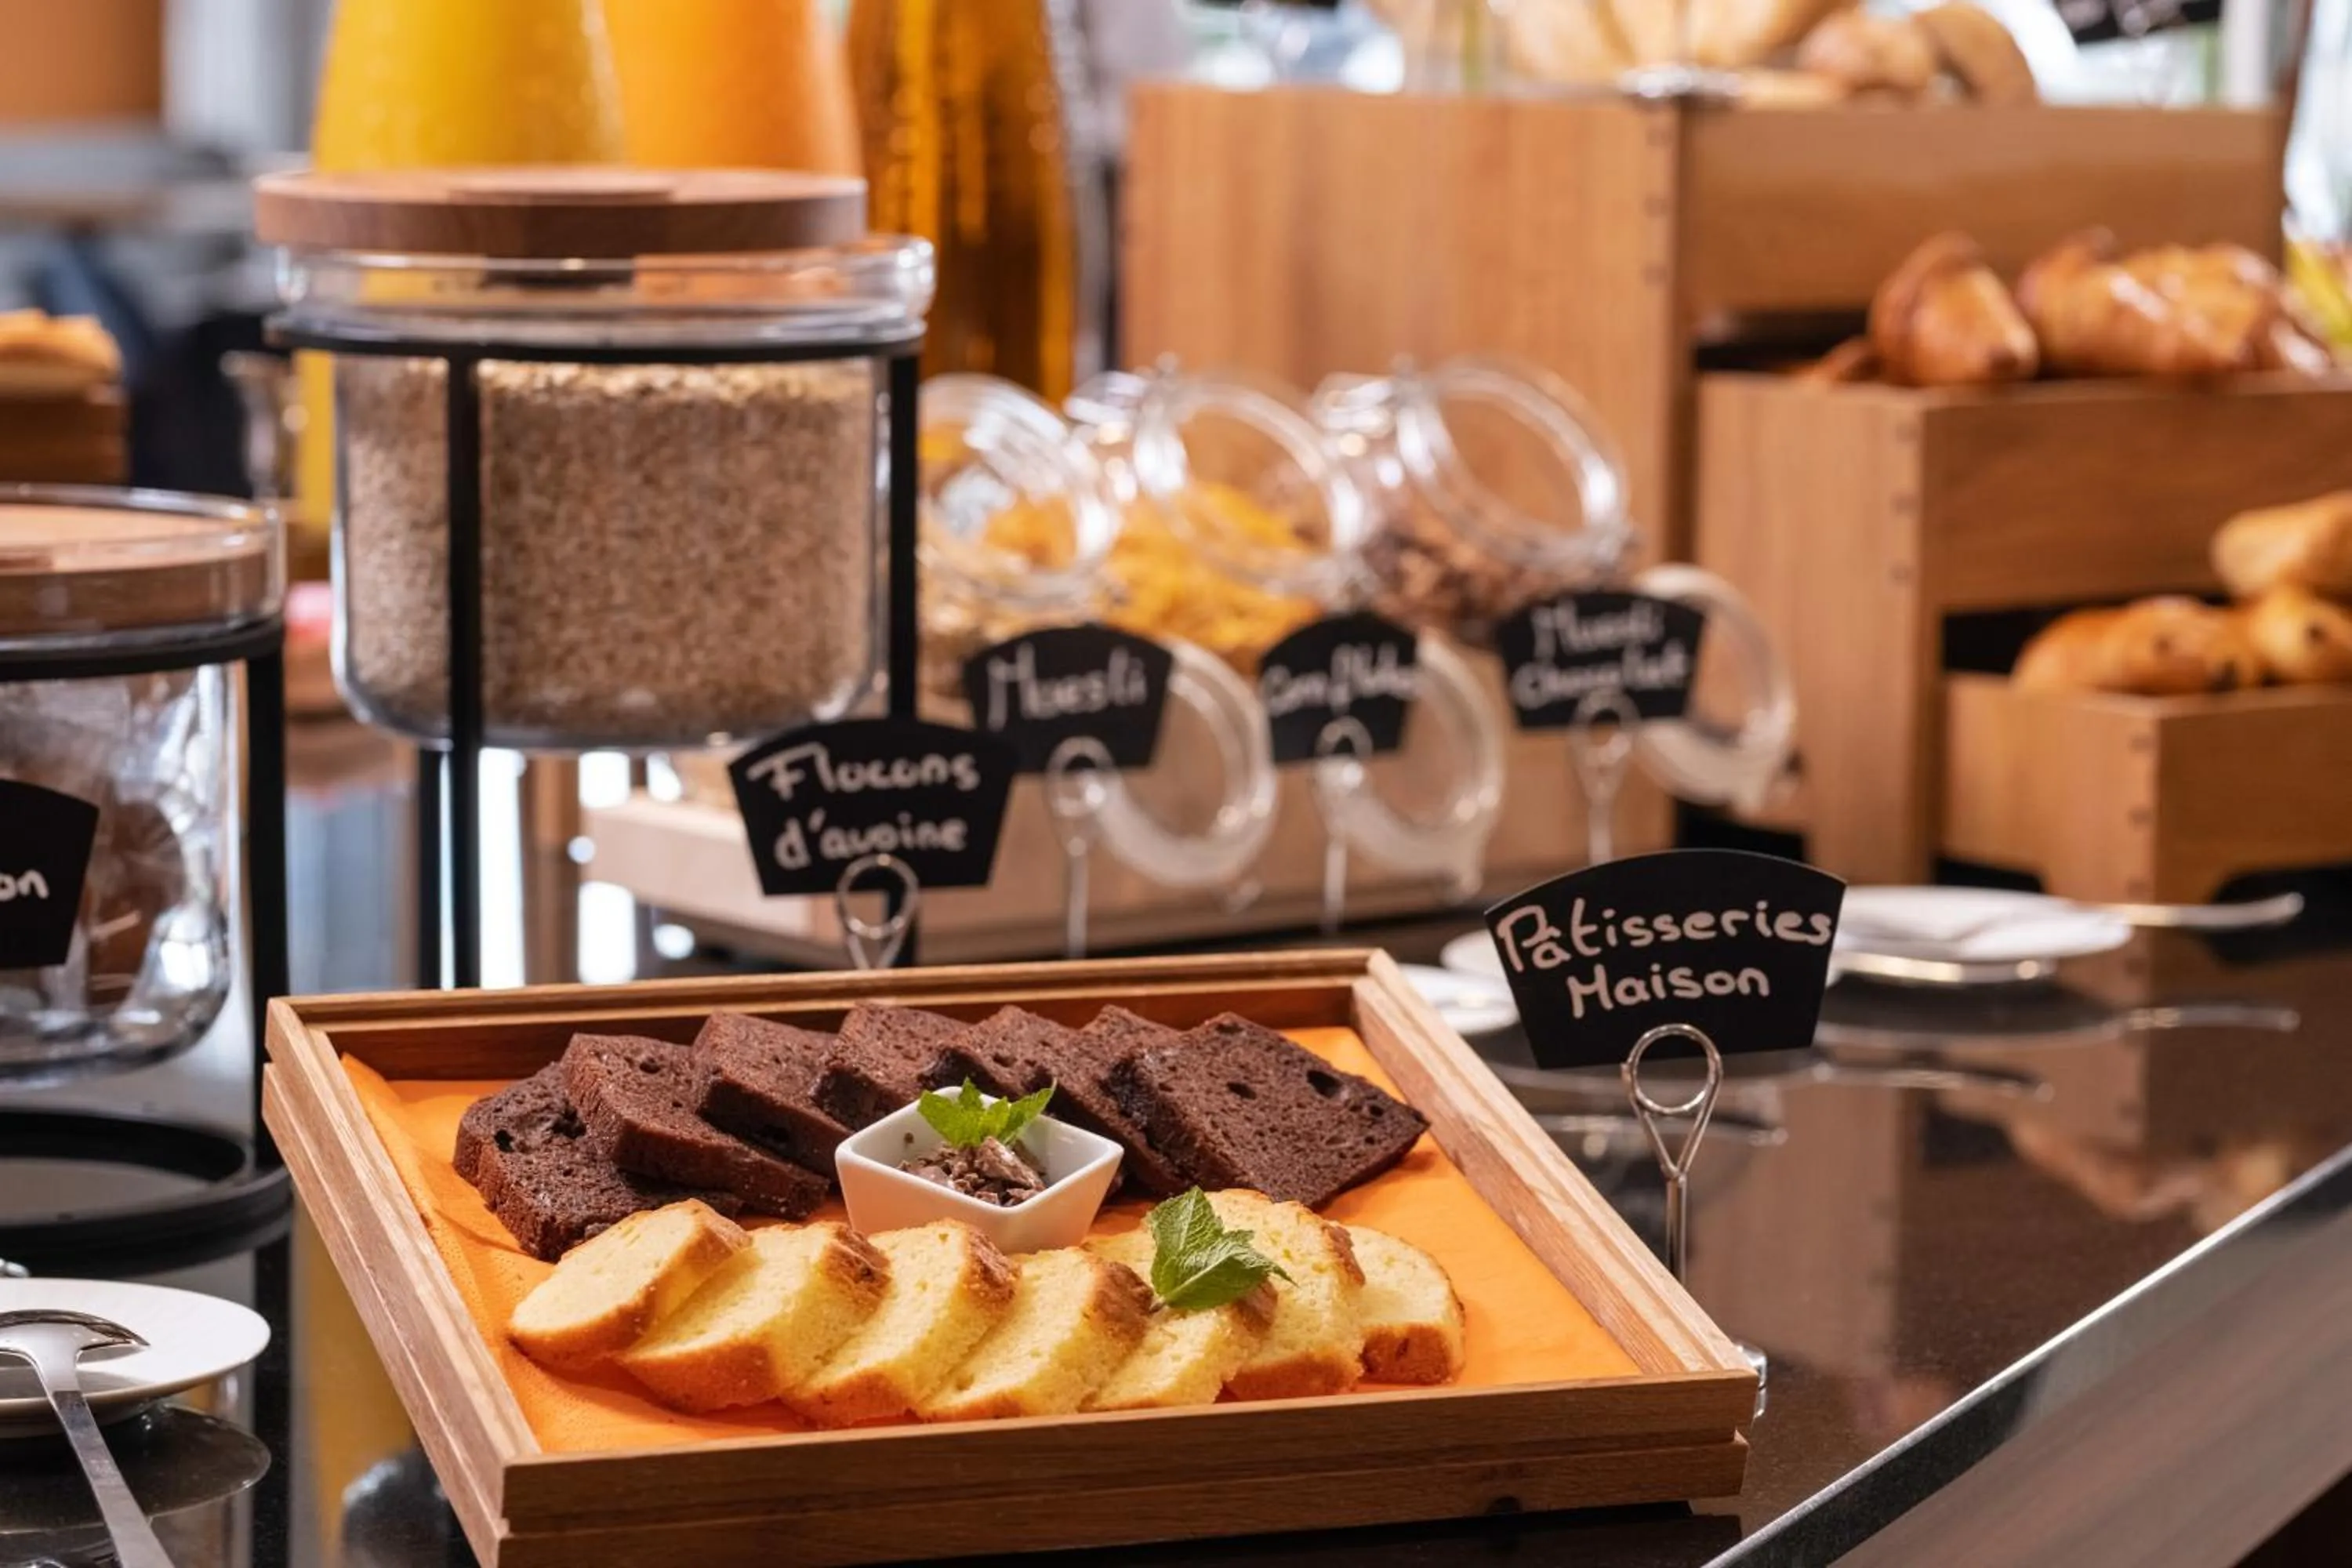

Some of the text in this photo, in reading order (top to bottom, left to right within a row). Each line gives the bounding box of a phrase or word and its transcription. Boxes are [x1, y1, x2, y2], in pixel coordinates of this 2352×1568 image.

[985, 640, 1148, 732] Muesli
[746, 742, 982, 800] Flocons
[773, 808, 968, 869] d'avoine
[1566, 963, 1770, 1019] Maison
